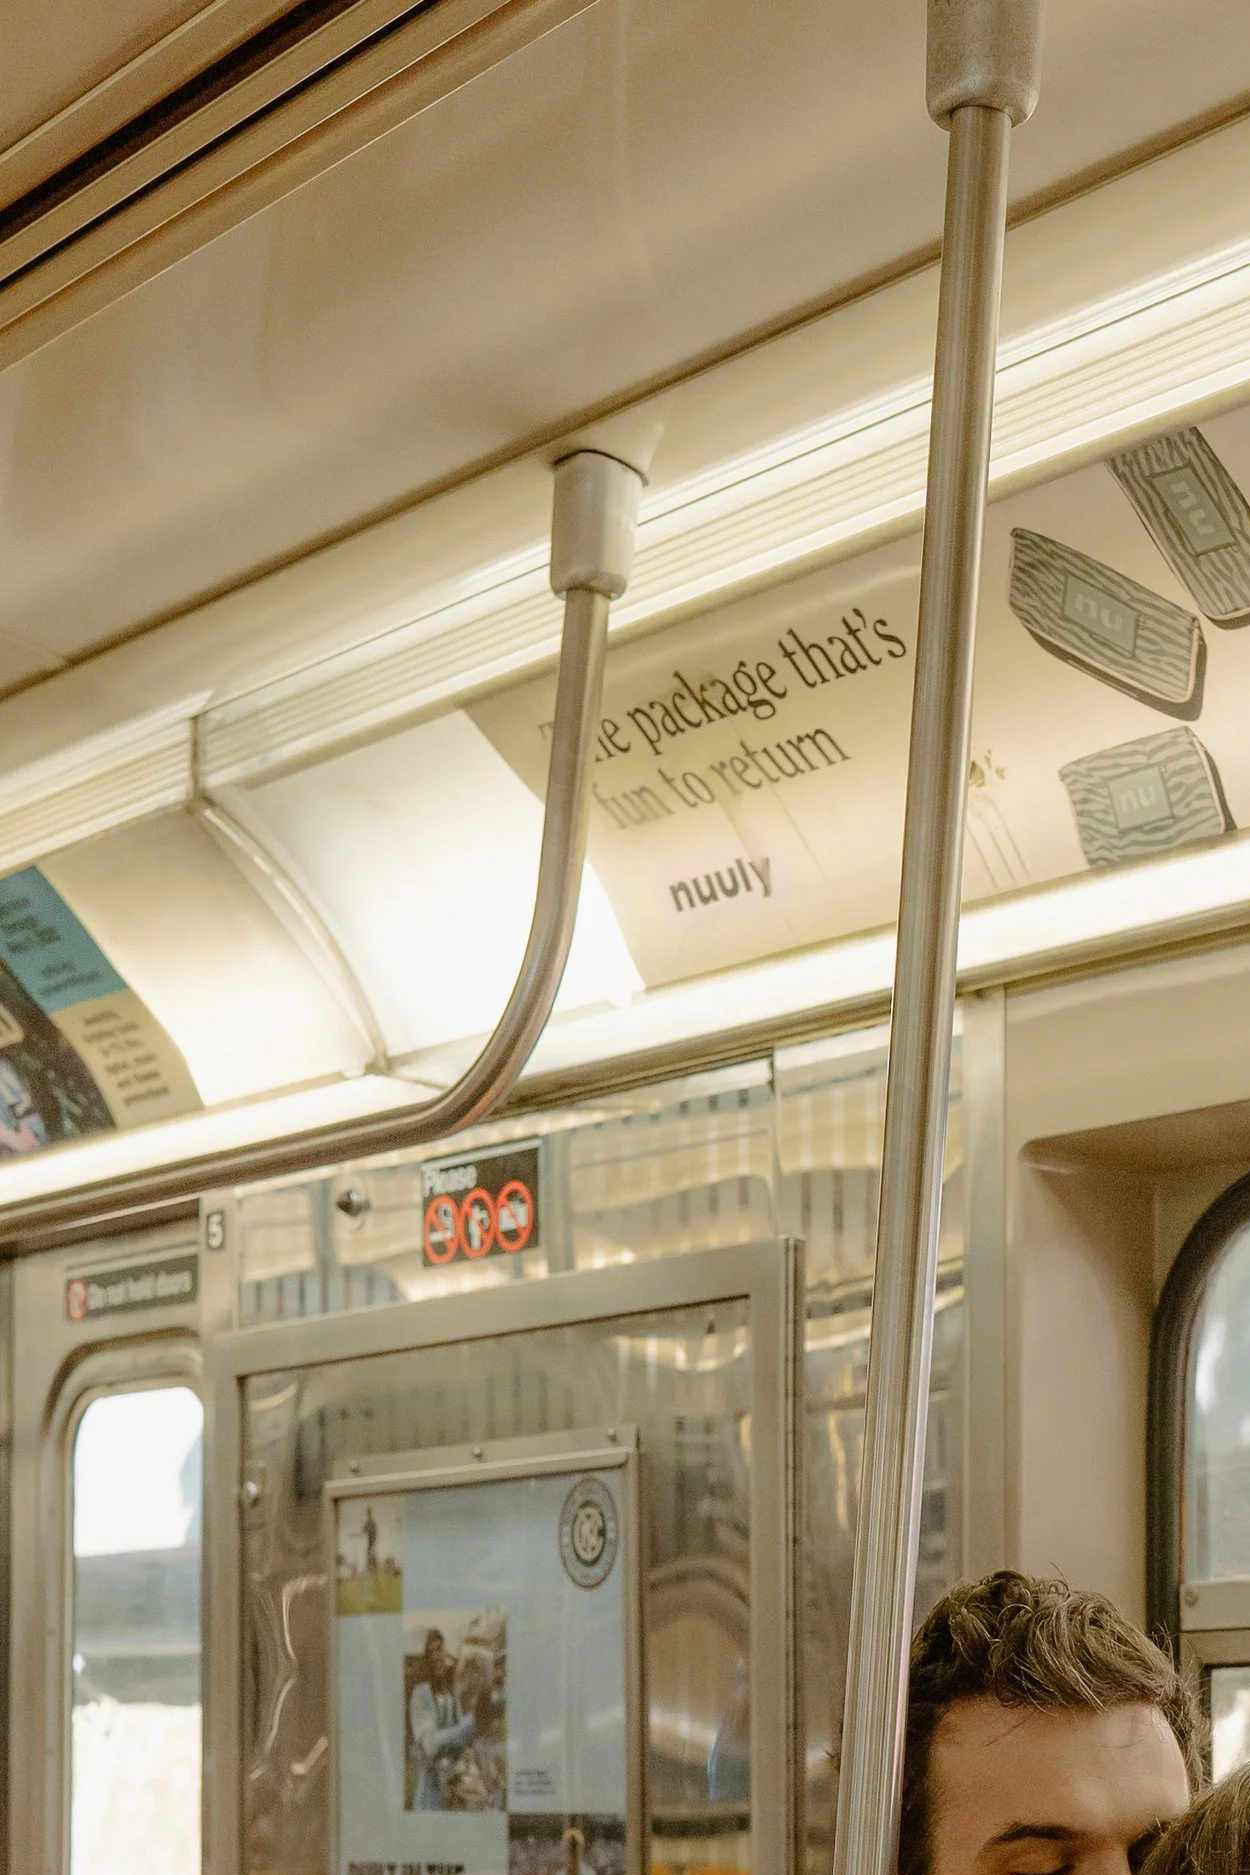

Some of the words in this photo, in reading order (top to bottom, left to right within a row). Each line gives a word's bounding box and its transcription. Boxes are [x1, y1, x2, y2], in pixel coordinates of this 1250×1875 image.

[626, 660, 787, 757] package
[778, 608, 908, 689] that's
[657, 767, 715, 809] to
[709, 727, 851, 796] return
[669, 857, 771, 912] nuuly
